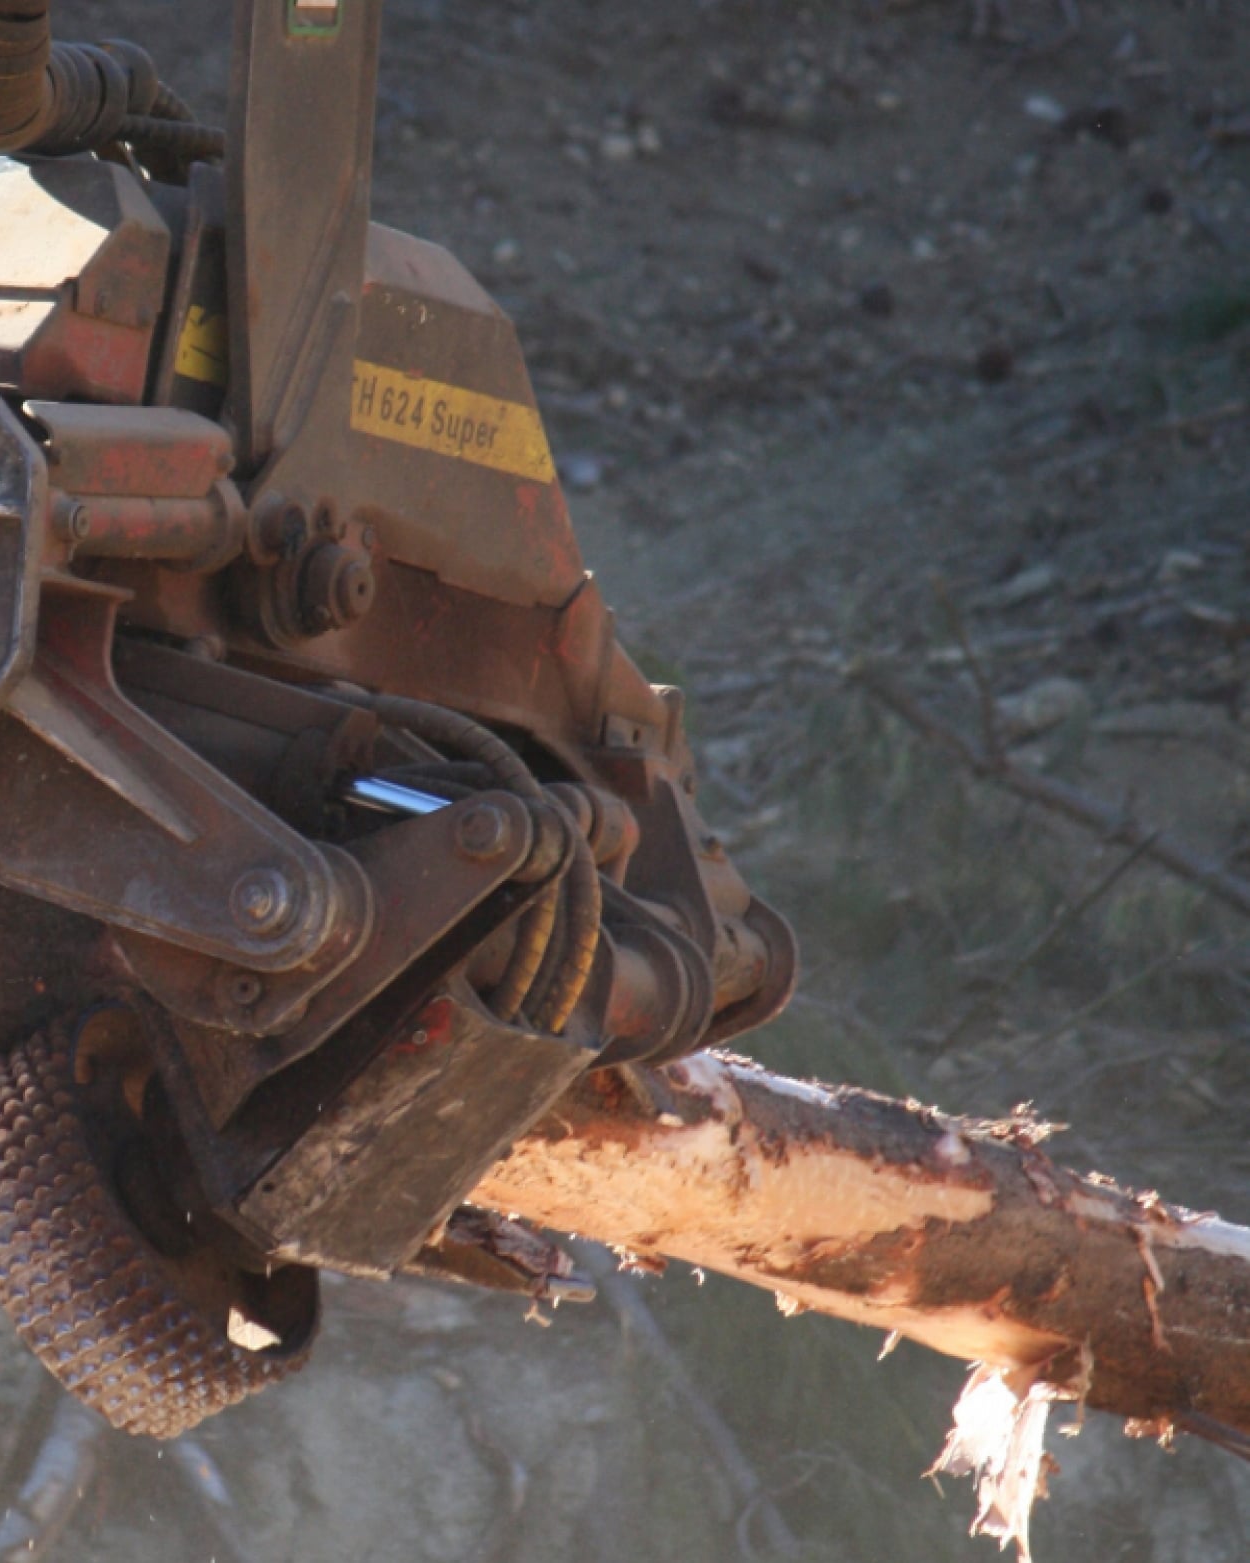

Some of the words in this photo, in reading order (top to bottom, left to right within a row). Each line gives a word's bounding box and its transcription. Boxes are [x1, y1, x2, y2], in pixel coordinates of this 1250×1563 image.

[353, 375, 378, 416] H
[380, 387, 424, 429] 624
[430, 400, 498, 450] Super
